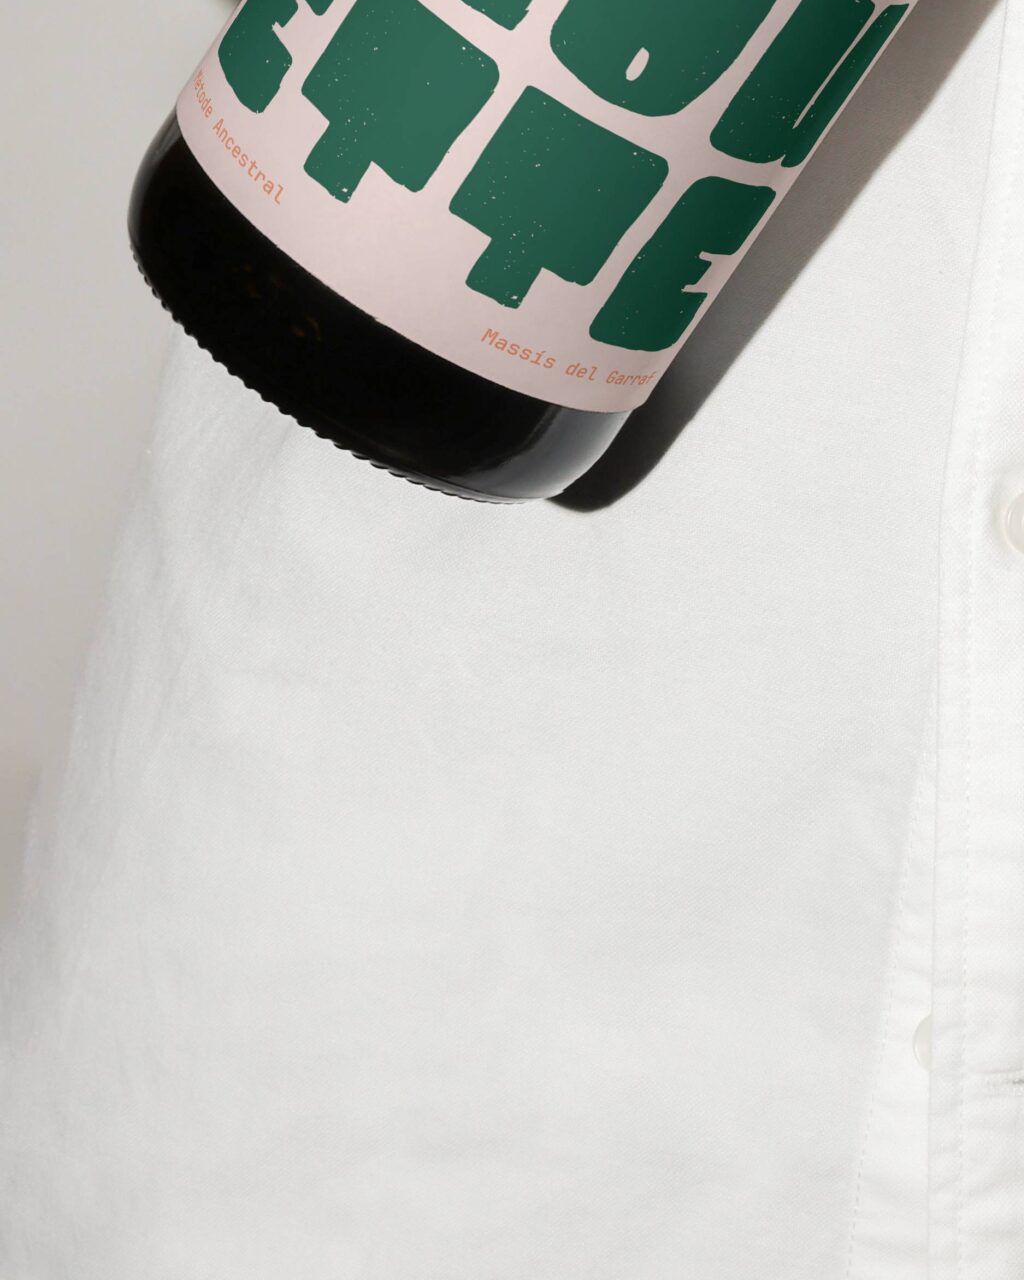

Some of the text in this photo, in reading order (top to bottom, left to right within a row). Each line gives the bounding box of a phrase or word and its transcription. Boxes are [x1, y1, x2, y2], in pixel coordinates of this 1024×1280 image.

[212, 118, 285, 205] Ancestral
[480, 328, 658, 386] Massís del Garraf
